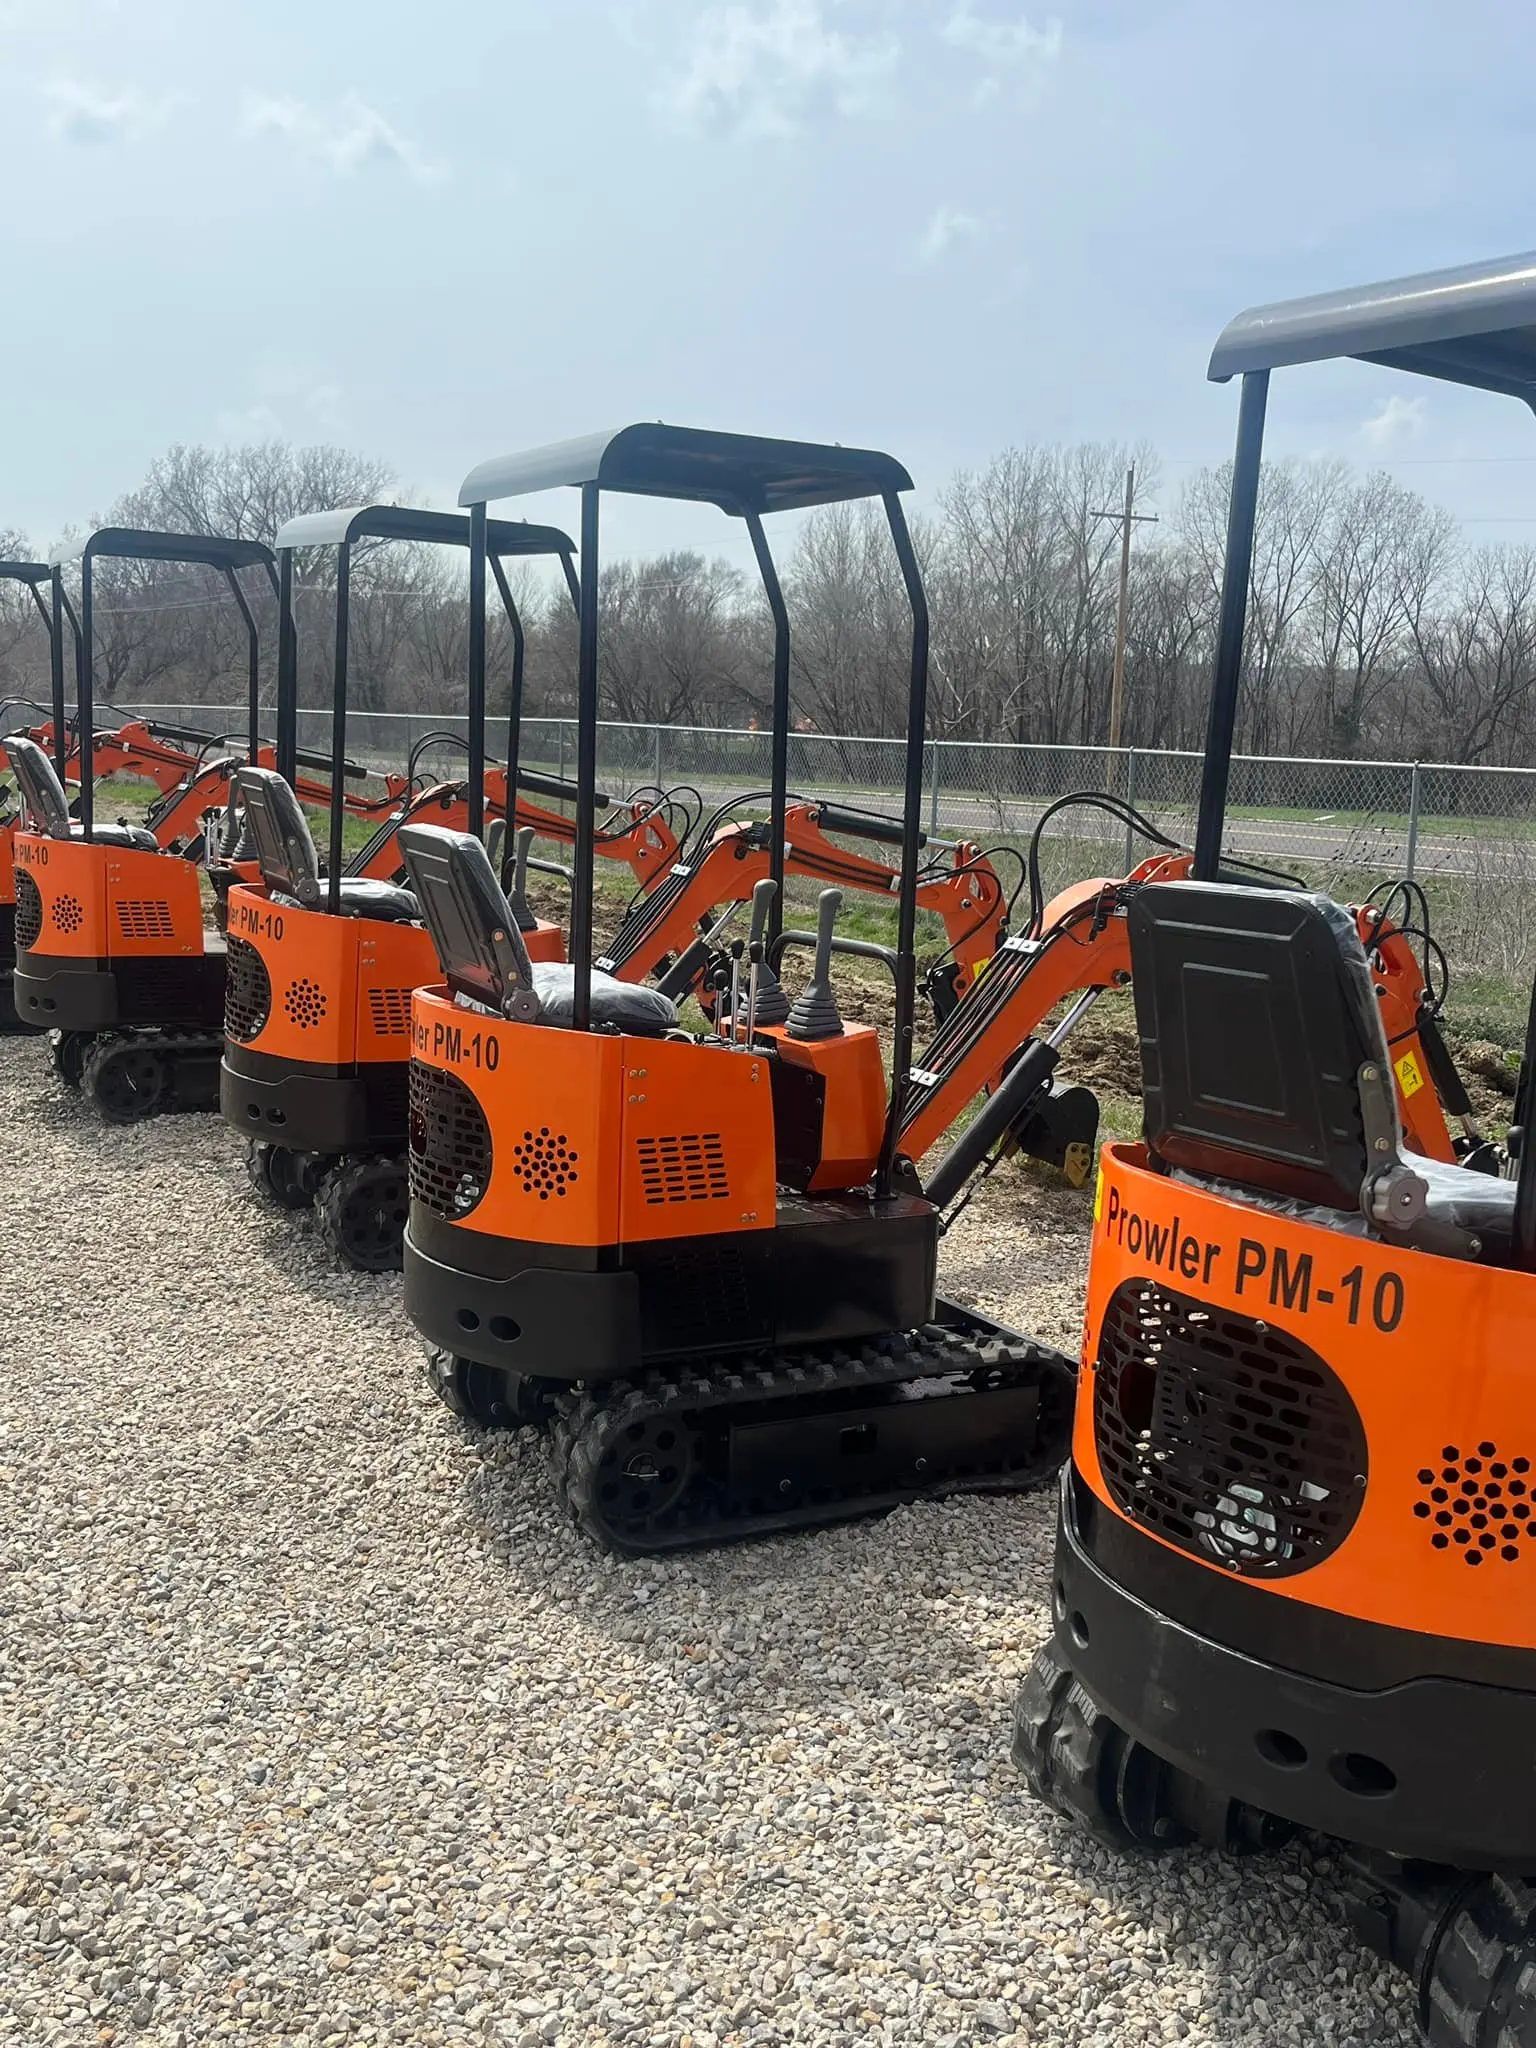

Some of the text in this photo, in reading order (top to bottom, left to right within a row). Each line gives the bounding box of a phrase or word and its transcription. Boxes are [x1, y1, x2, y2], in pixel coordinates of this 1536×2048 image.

[19, 844, 48, 866] PM-10
[240, 905, 284, 941] PM-10
[434, 1022, 499, 1071] PM-10
[1106, 1186, 1405, 1333] Prowler PM-10
